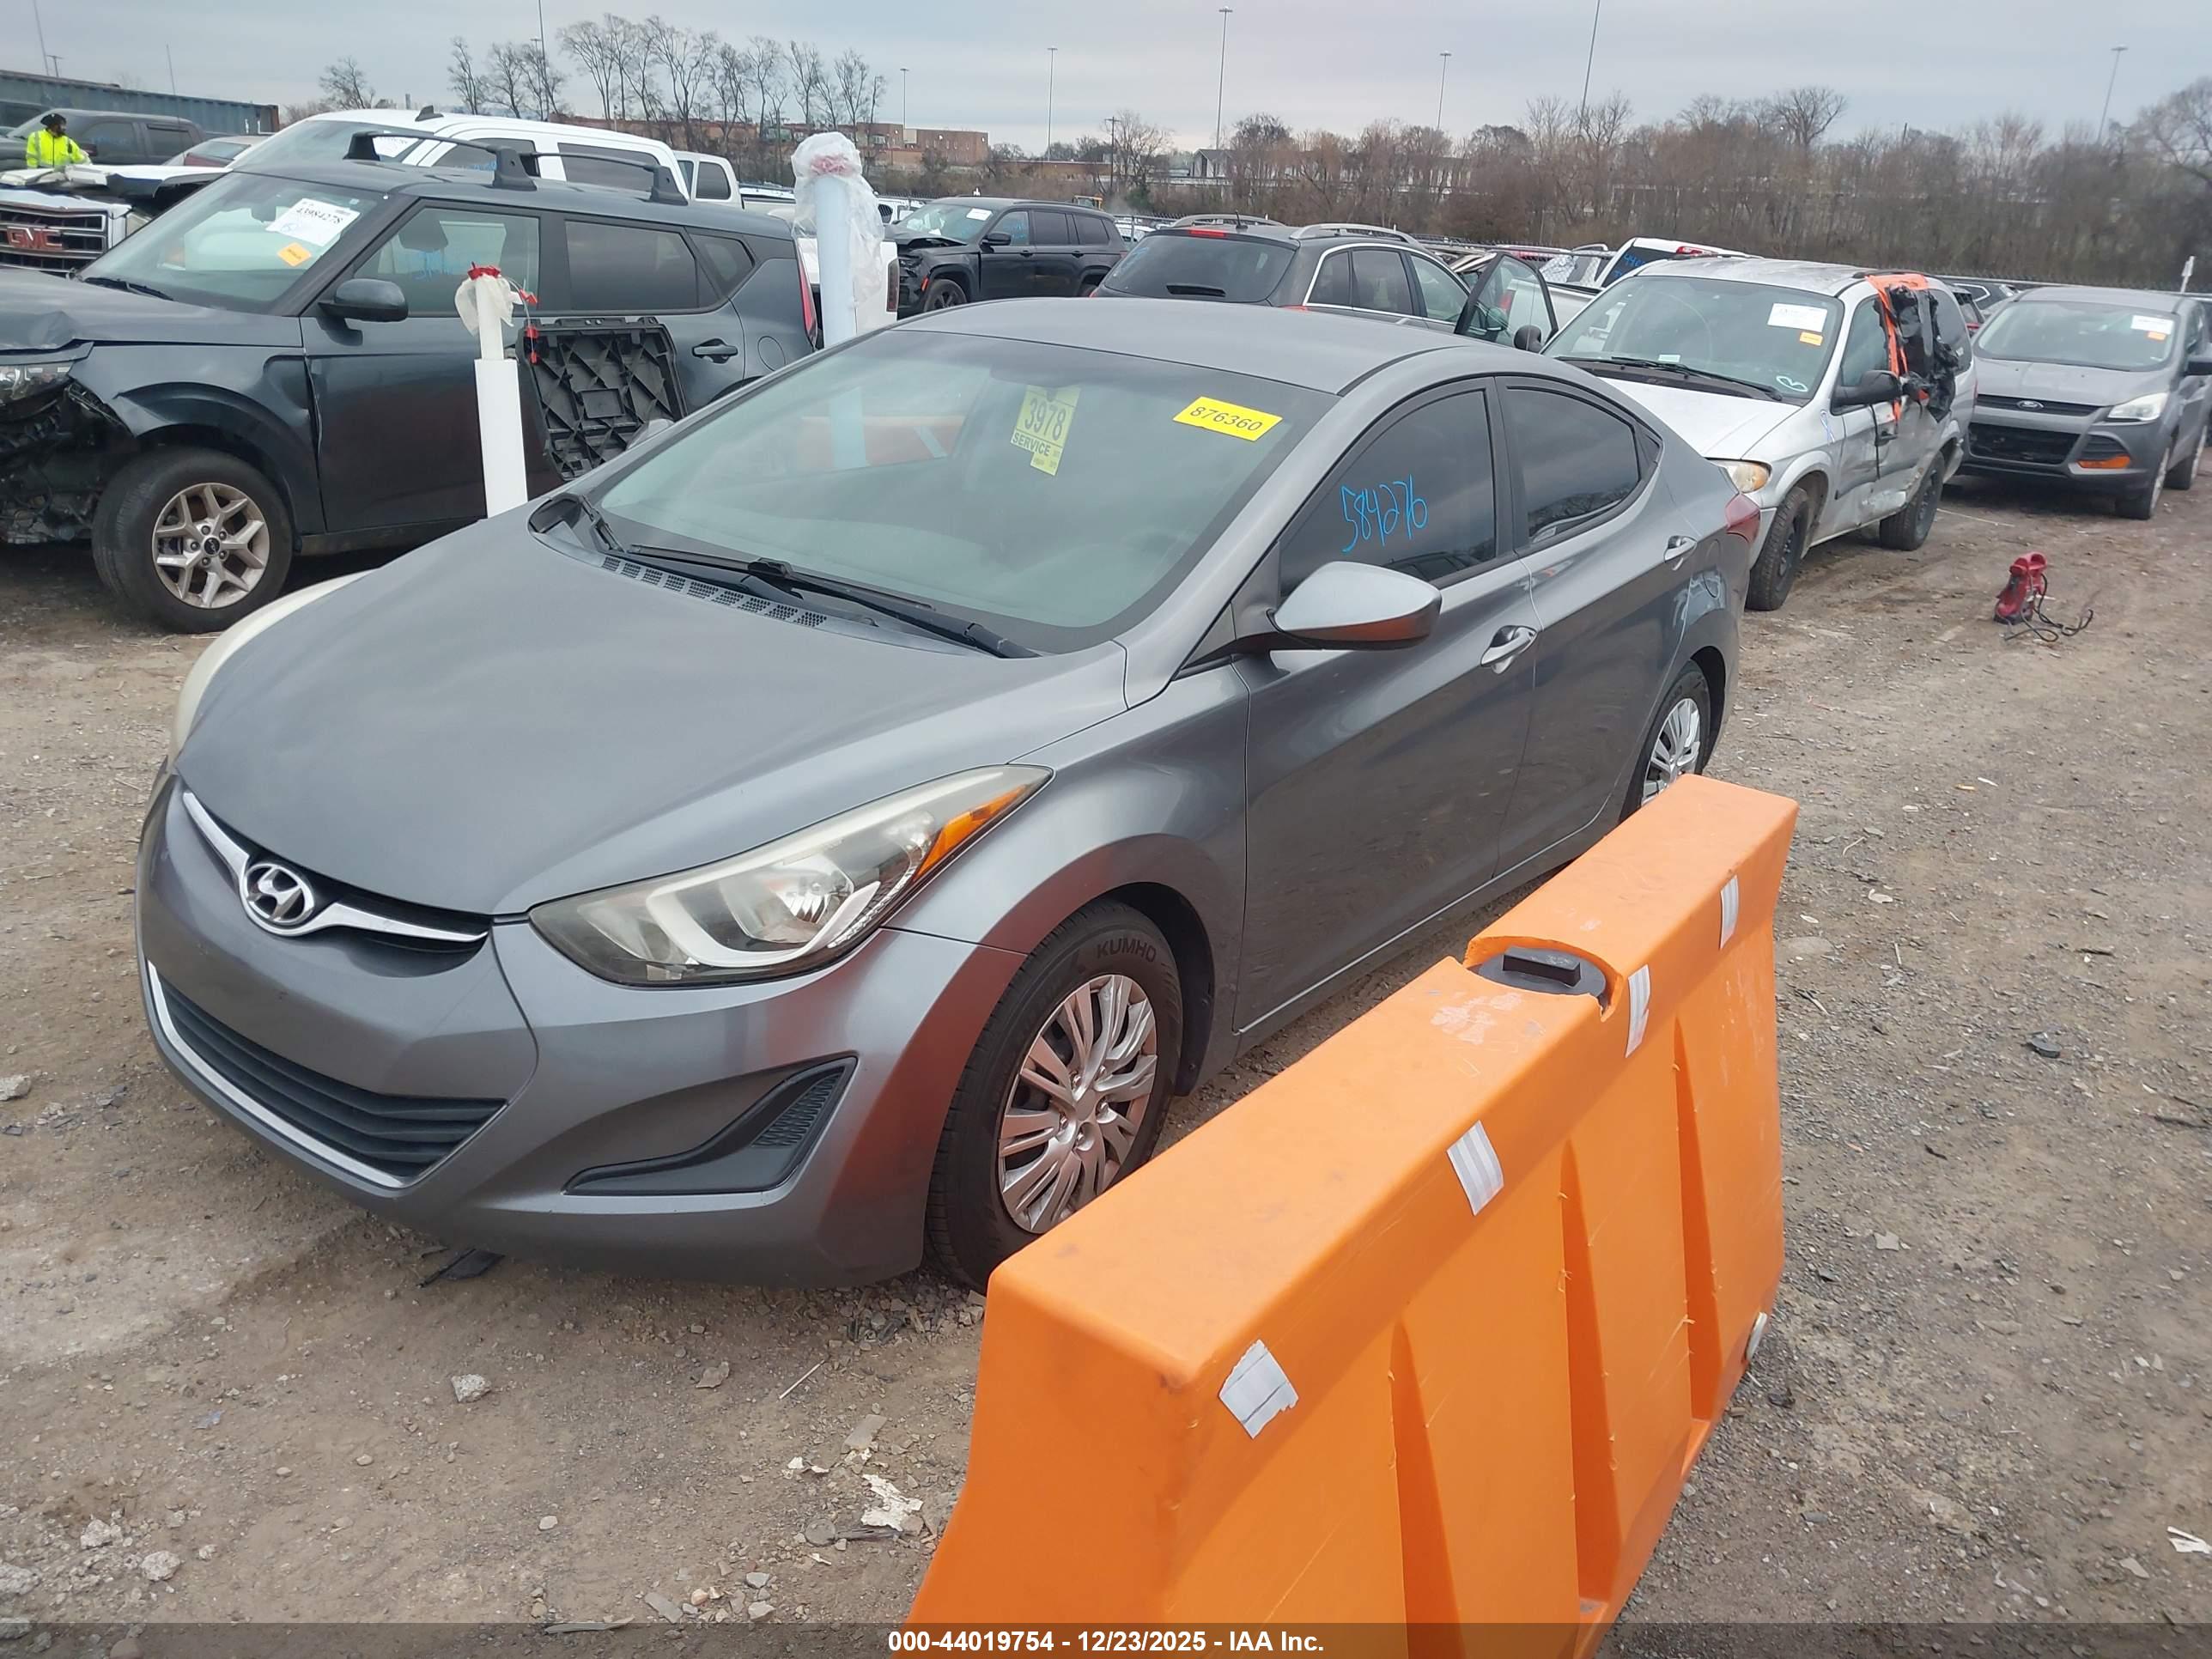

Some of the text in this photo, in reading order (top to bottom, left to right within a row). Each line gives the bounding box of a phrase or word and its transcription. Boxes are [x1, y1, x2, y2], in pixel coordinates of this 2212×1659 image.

[7, 226, 63, 250] GMC
[1024, 398, 1066, 441] 3978
[1189, 406, 1263, 431] 876360
[1013, 432, 1051, 457] SERVICE
[1340, 473, 1428, 553] 584276
[1097, 938, 1157, 963] KUMHO
